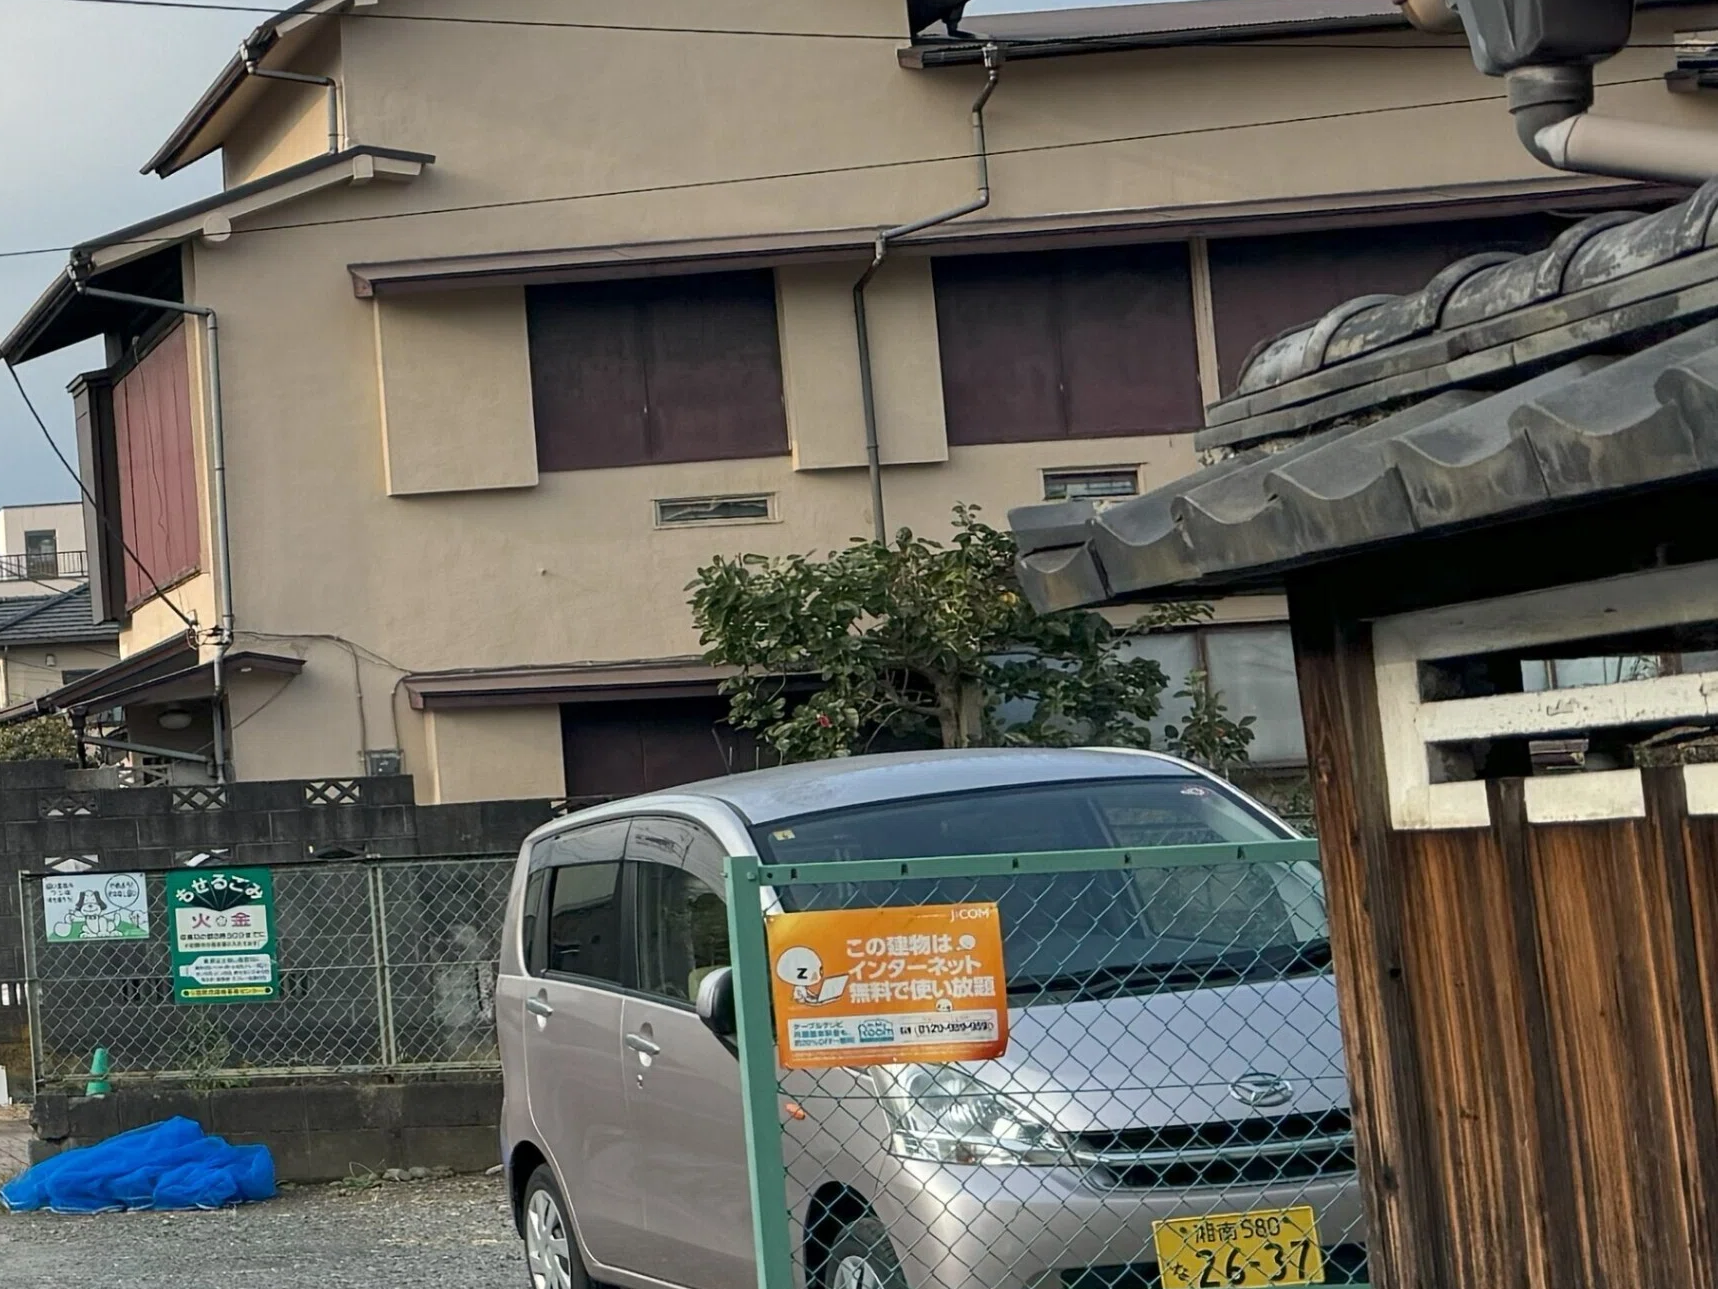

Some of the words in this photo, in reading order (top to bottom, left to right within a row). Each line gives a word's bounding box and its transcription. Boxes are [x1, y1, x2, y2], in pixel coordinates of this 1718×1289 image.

[192, 913, 211, 929] 火
[231, 912, 251, 927] 金
[846, 934, 952, 958] この建物は
[849, 955, 982, 980] インターネット
[849, 976, 996, 1004] 無料で使い放題
[1195, 1240, 1310, 1288] 26-37
